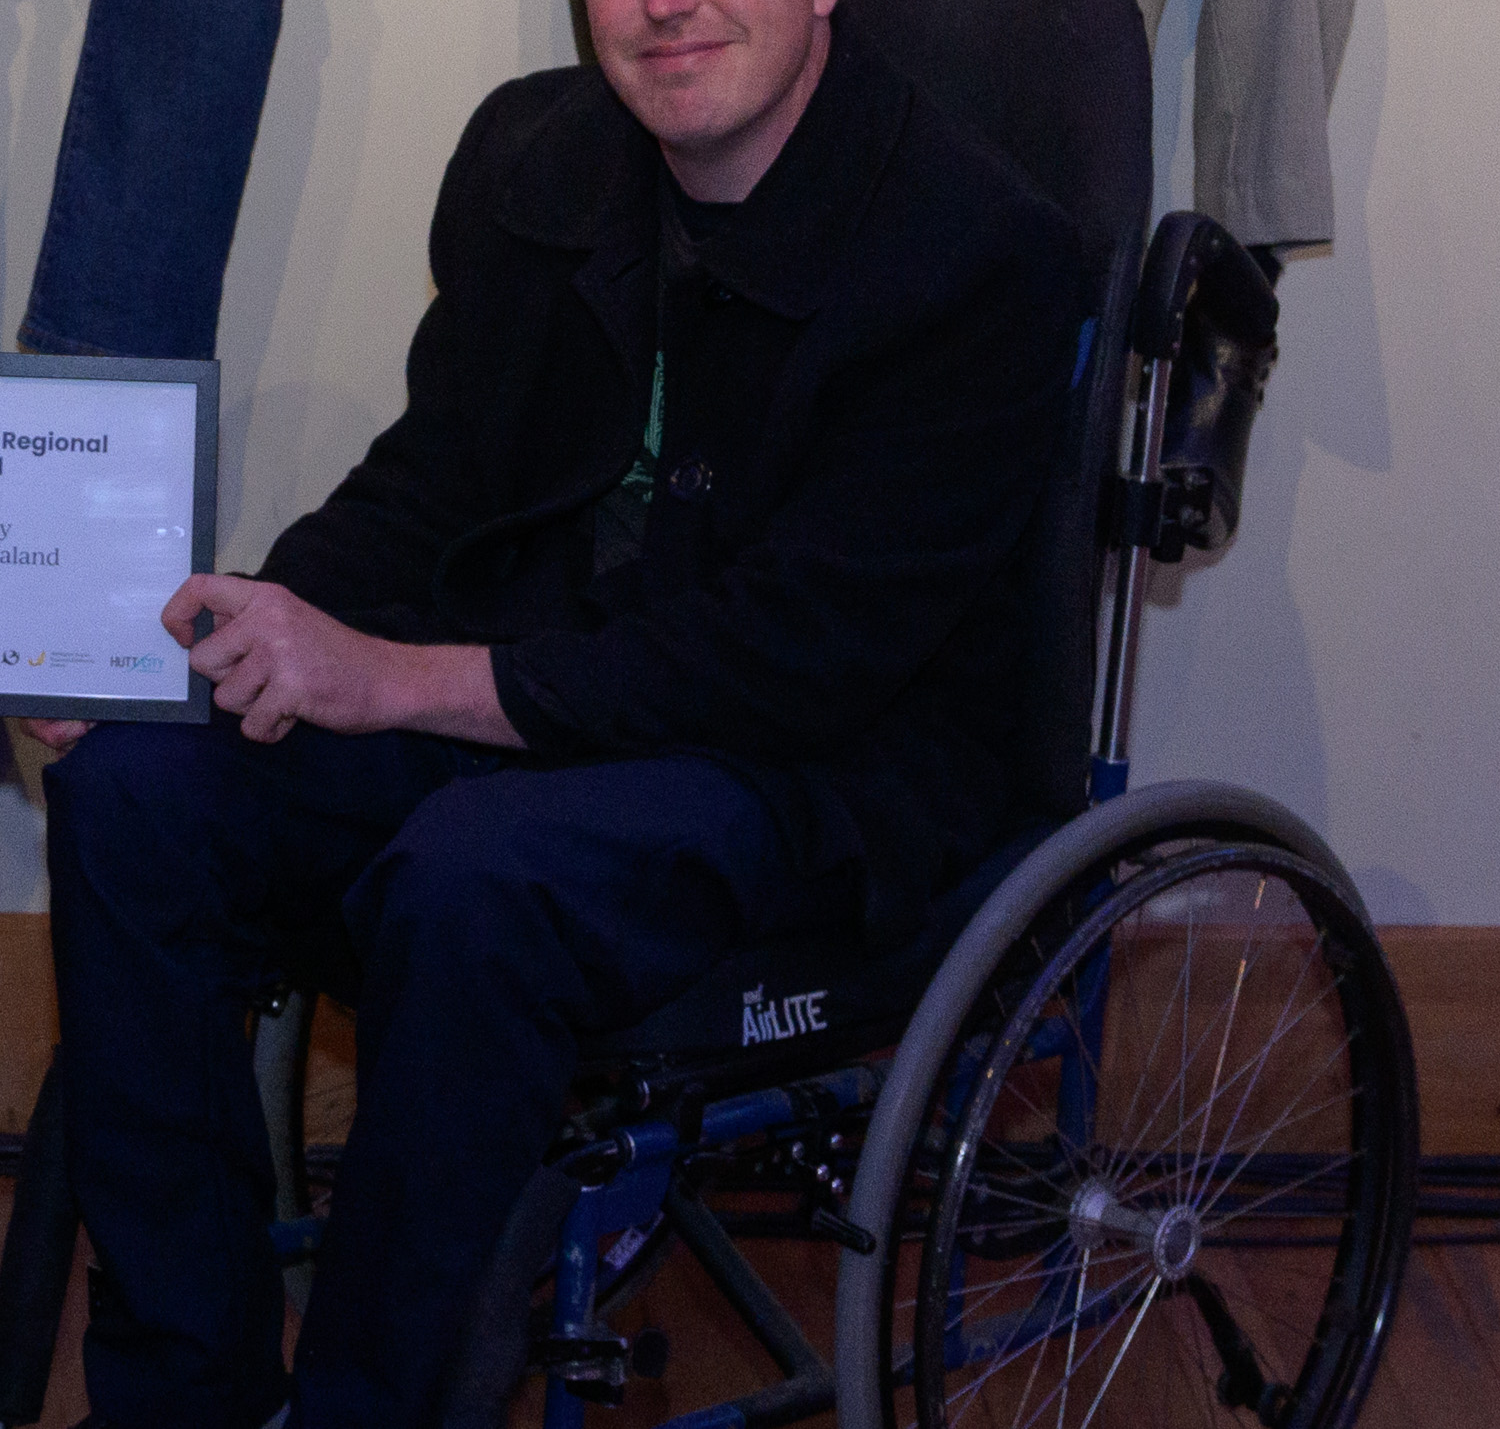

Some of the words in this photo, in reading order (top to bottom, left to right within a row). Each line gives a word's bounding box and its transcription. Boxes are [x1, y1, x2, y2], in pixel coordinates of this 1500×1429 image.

[2, 431, 109, 457] Regional
[110, 656, 138, 668] HUTT
[742, 990, 829, 1047] AirLITE
